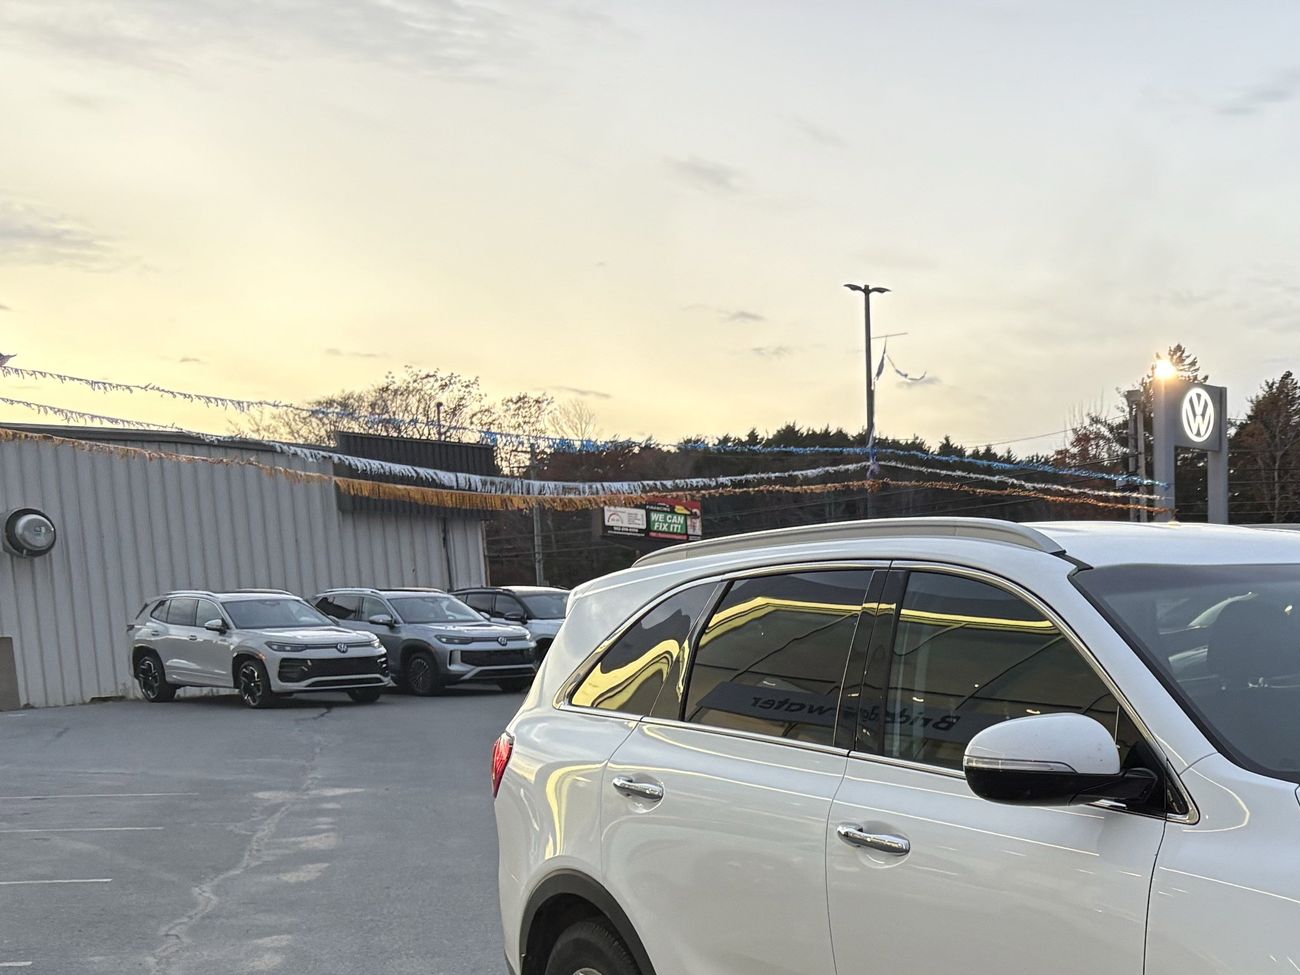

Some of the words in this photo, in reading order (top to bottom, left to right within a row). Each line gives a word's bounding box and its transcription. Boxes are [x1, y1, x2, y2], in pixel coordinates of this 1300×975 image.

[650, 512, 665, 522] WE
[666, 514, 684, 524] CAN
[654, 523, 669, 532] FIX
[670, 524, 681, 533] IT!
